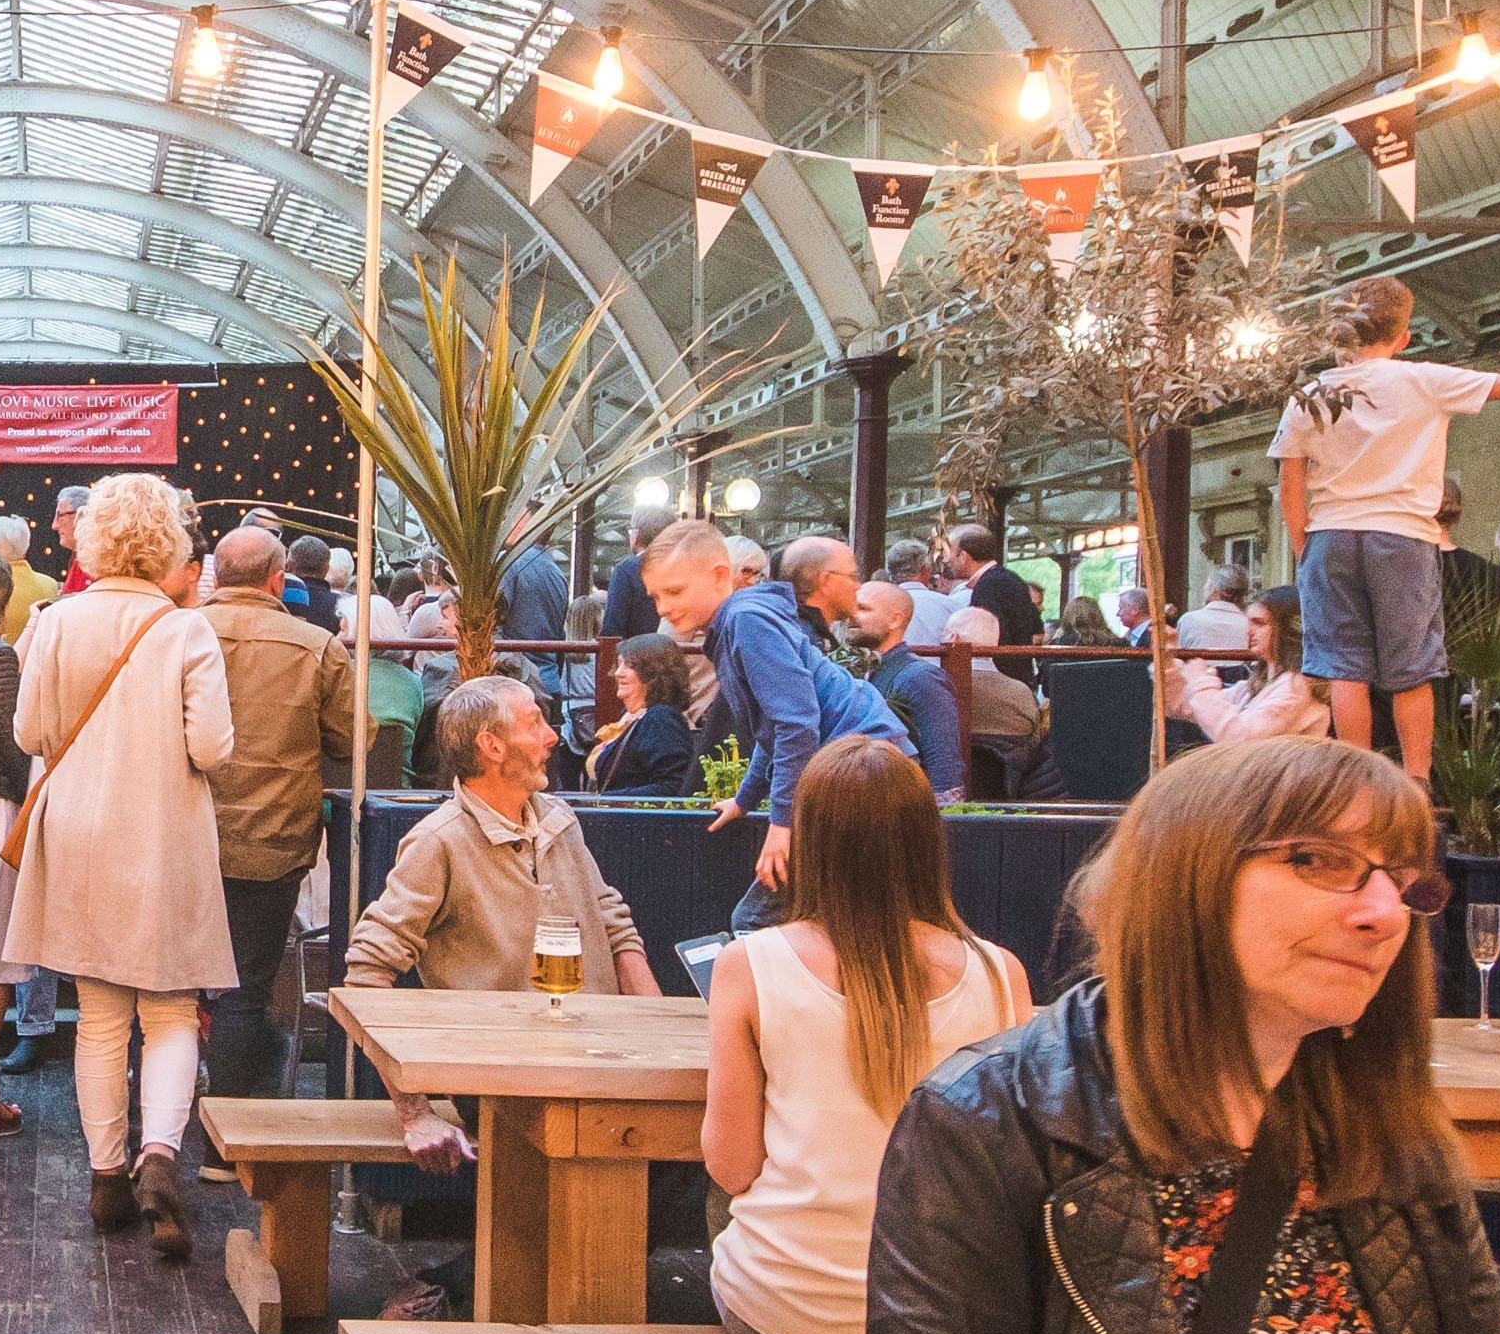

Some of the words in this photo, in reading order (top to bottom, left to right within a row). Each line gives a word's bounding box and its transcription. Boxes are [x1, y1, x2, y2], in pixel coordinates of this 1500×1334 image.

[408, 46, 427, 62] Bath
[397, 50, 430, 73] Function
[395, 60, 422, 80] Rooms
[700, 169, 725, 181] GREEN
[725, 175, 747, 186] PARK
[700, 178, 744, 195] BRASSERIE
[881, 195, 901, 205] Bath
[872, 204, 909, 214] Function
[875, 213, 905, 224] Rooms
[87, 395, 115, 408] LIVE
[120, 395, 166, 408] MUSIC
[110, 411, 167, 420] EXCELLENCE
[7, 428, 35, 436] Proud
[36, 428, 47, 436] to
[48, 428, 85, 439] support
[87, 428, 108, 436] Bath
[111, 427, 150, 436] Festivals
[15, 444, 142, 455] www.kingswood.bath.sch.uk
